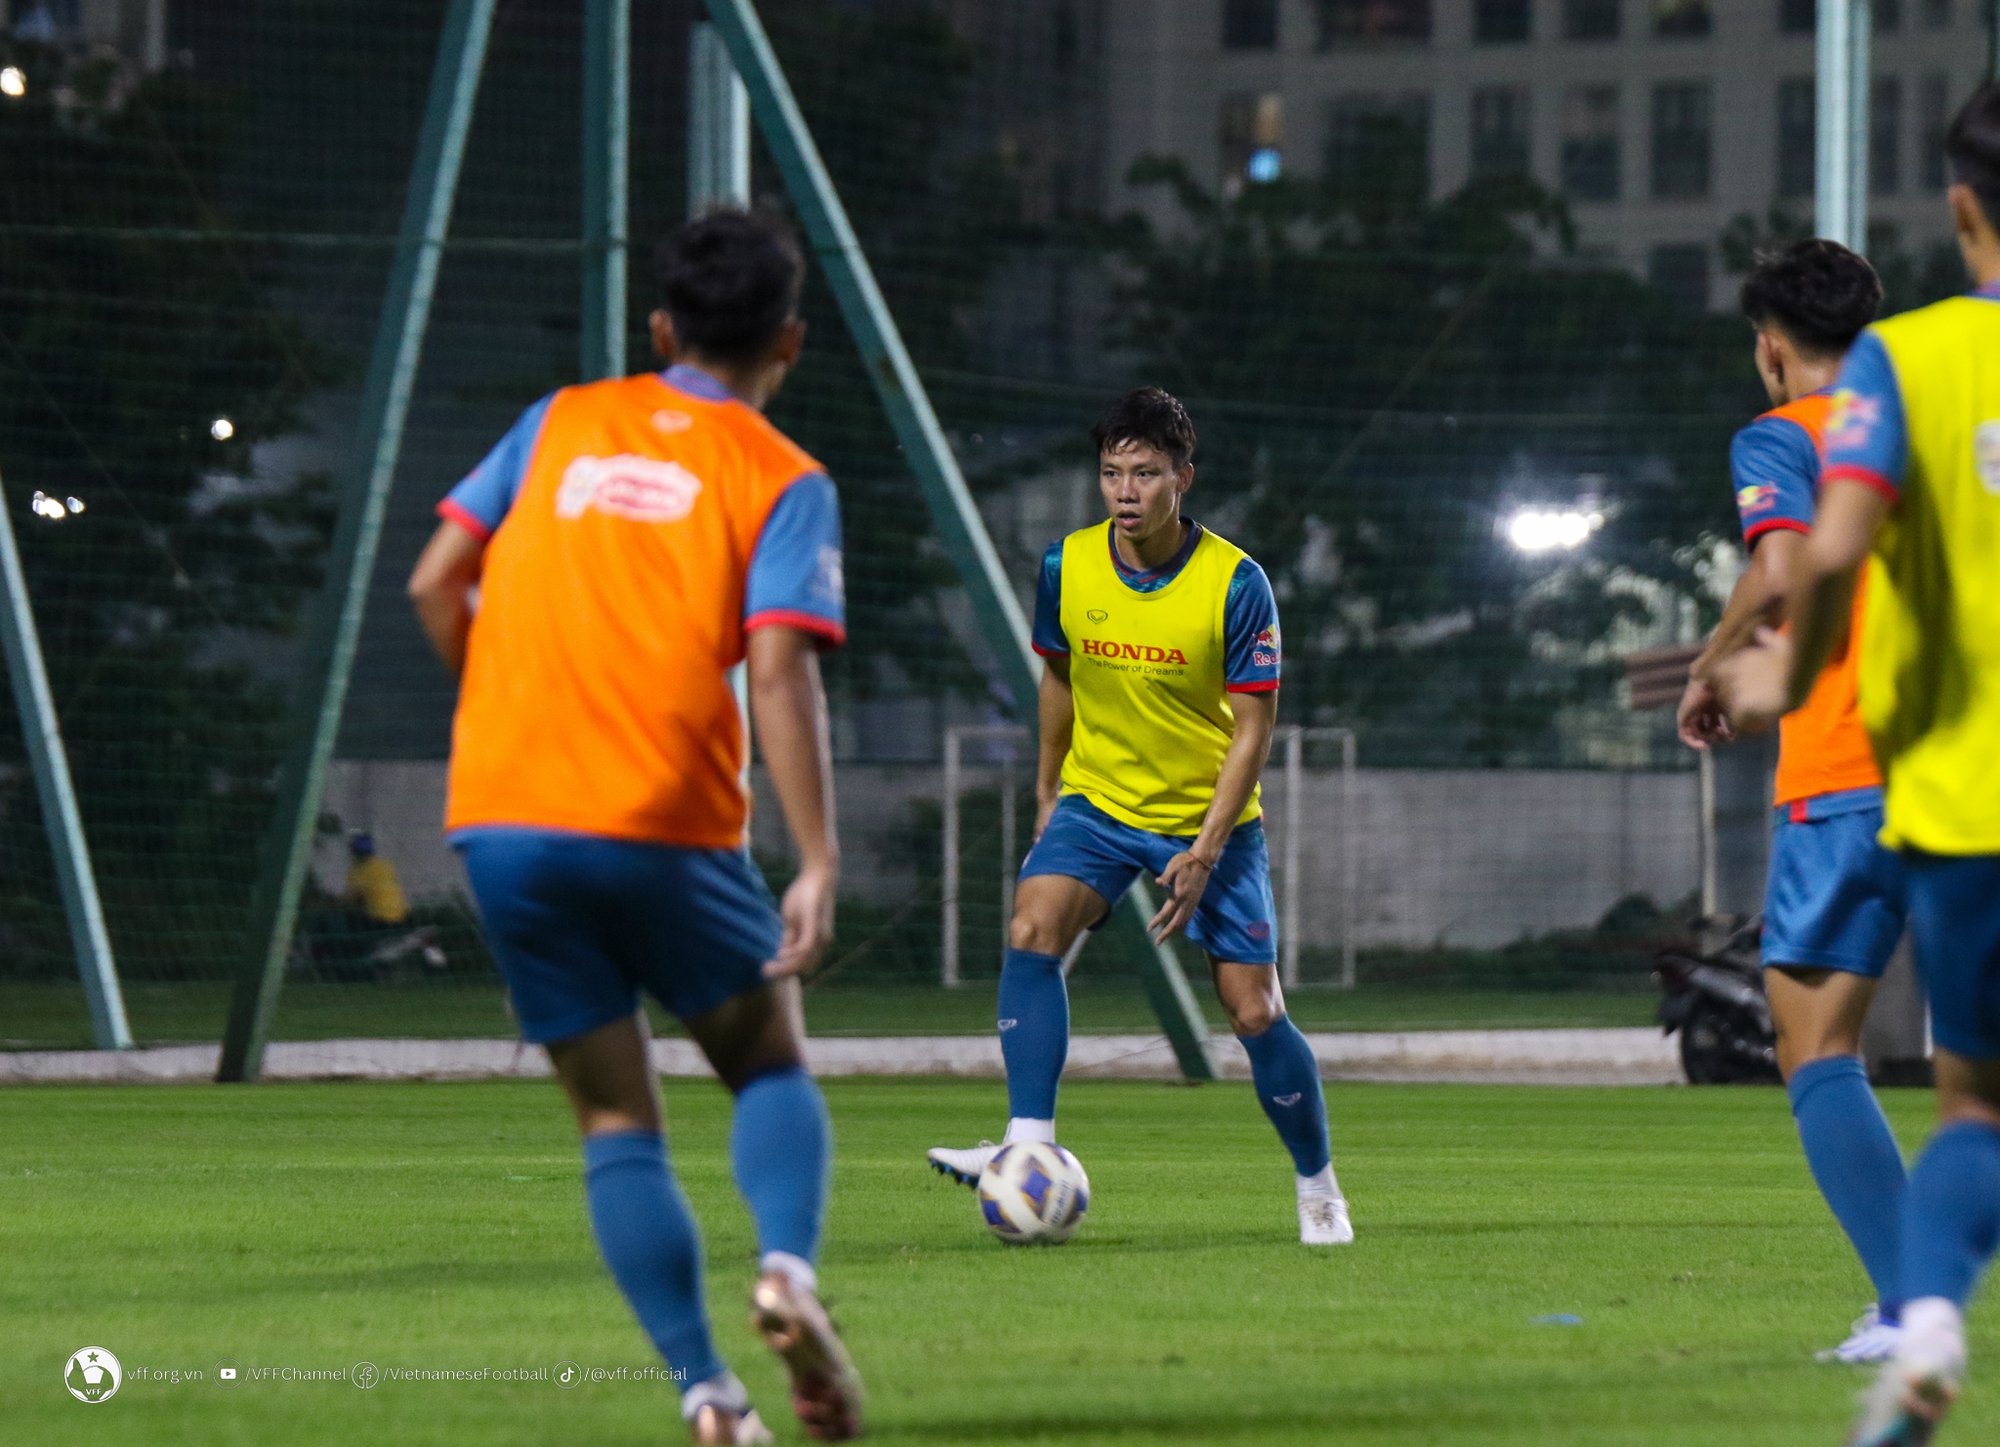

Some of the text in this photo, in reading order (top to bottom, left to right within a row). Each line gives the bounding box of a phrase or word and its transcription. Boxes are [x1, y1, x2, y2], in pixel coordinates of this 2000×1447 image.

[1081, 638, 1189, 665] HONDA
[1253, 651, 1277, 666] Red
[1087, 657, 1184, 676] The Power of Dreams
